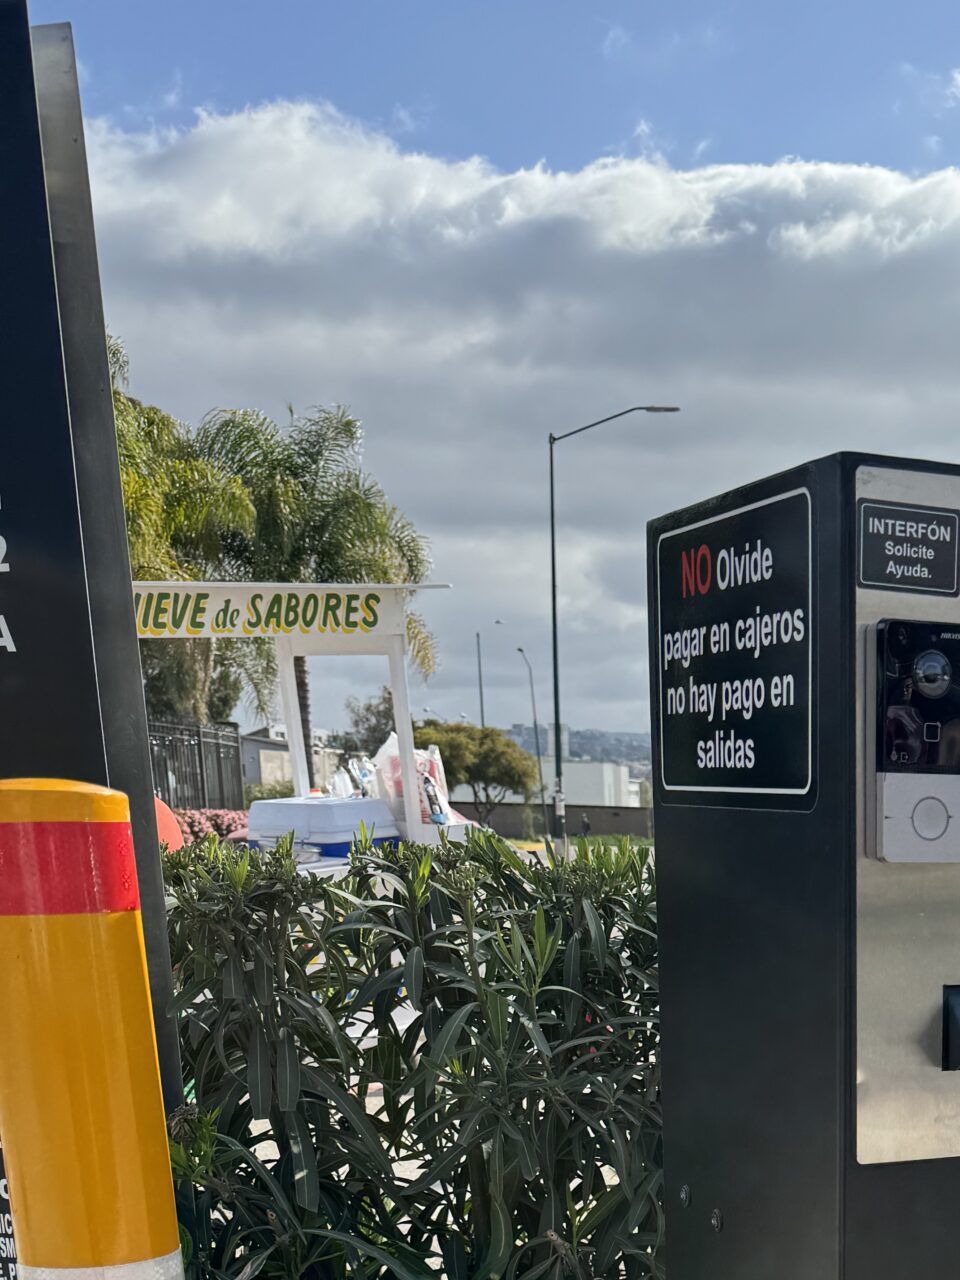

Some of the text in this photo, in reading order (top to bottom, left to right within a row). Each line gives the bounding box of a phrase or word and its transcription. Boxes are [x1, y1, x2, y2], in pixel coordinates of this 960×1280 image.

[869, 517, 951, 542] INTERFÓN
[681, 539, 773, 599] NO Olvide
[885, 541, 935, 560] Solicite
[886, 560, 932, 578] Ayuda.
[214, 598, 240, 631] de
[245, 592, 381, 632] SABORES
[664, 605, 805, 671] pagar en cajeros
[667, 674, 794, 722] no hay pago en
[697, 729, 755, 769] salidas
